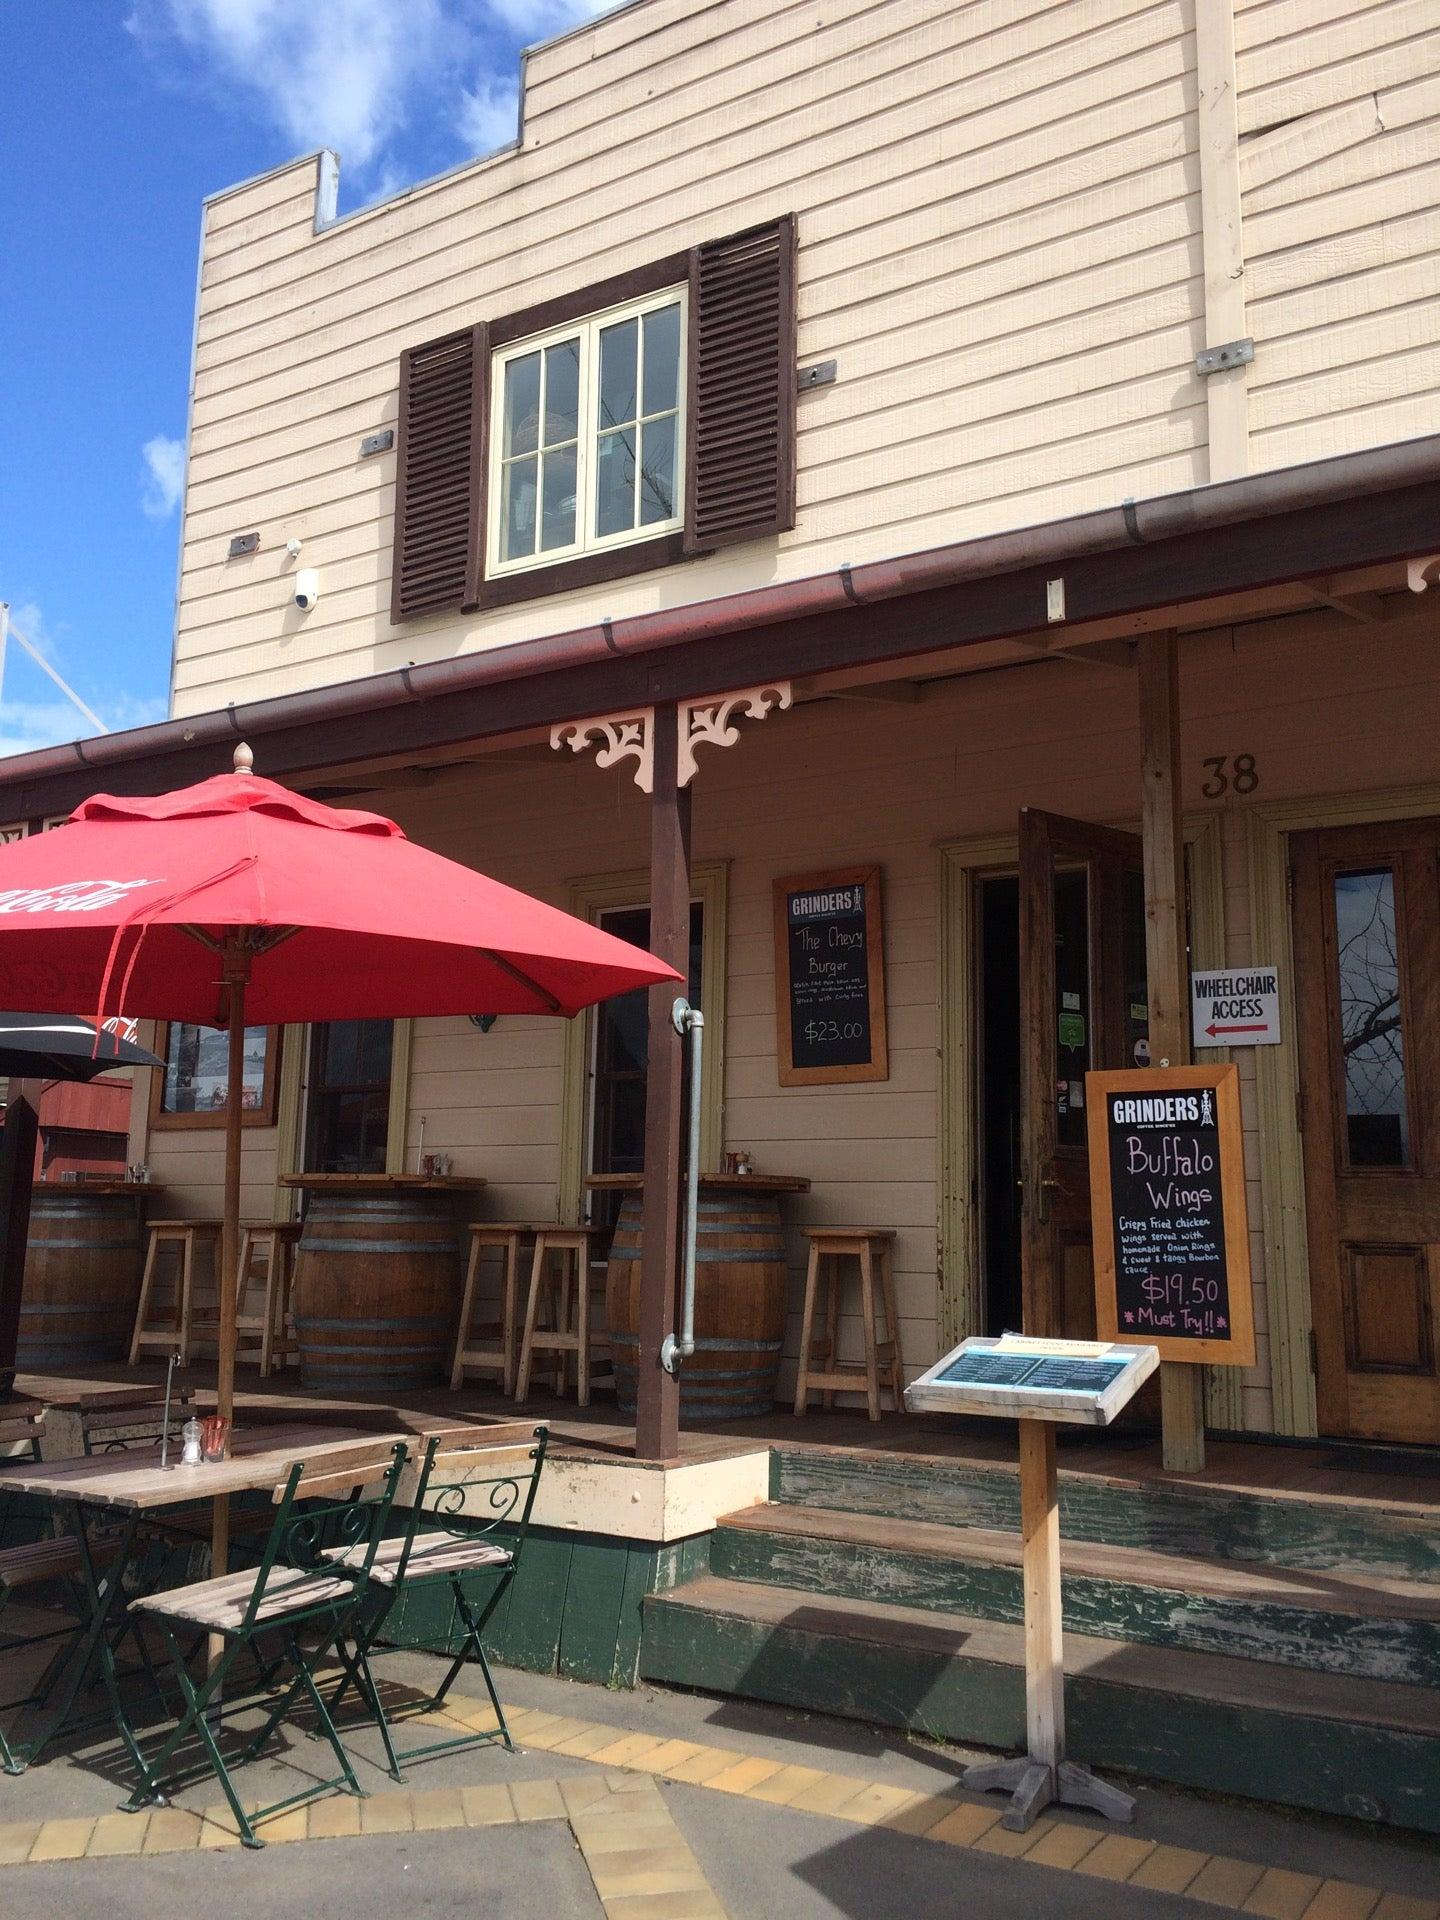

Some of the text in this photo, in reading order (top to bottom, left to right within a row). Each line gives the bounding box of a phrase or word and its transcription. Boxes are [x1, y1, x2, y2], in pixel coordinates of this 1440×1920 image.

[1202, 753, 1259, 799] 38
[792, 891, 852, 916] GRINDERS
[795, 926, 863, 951] The Chevy
[808, 957, 849, 978] Burger
[1194, 975, 1277, 998] WHEELCHAIR
[1211, 998, 1264, 1019] ACCESS
[804, 1019, 863, 1045] $23.00
[1113, 1096, 1199, 1124] GRINDERS
[1126, 1136, 1213, 1176] Buffalo
[1145, 1181, 1212, 1213] Wings
[1119, 1216, 1211, 1231] Crispy Fried chicken
[1121, 1231, 1204, 1244] wings served with
[1122, 1242, 1216, 1254] homemade Onion Rings
[1130, 1256, 1152, 1264] sweet
[1162, 1254, 1187, 1264] tangy
[1188, 1253, 1220, 1262] Bourbon
[1141, 1274, 1218, 1305] $19.50
[1137, 1307, 1215, 1336] Must Try!!
